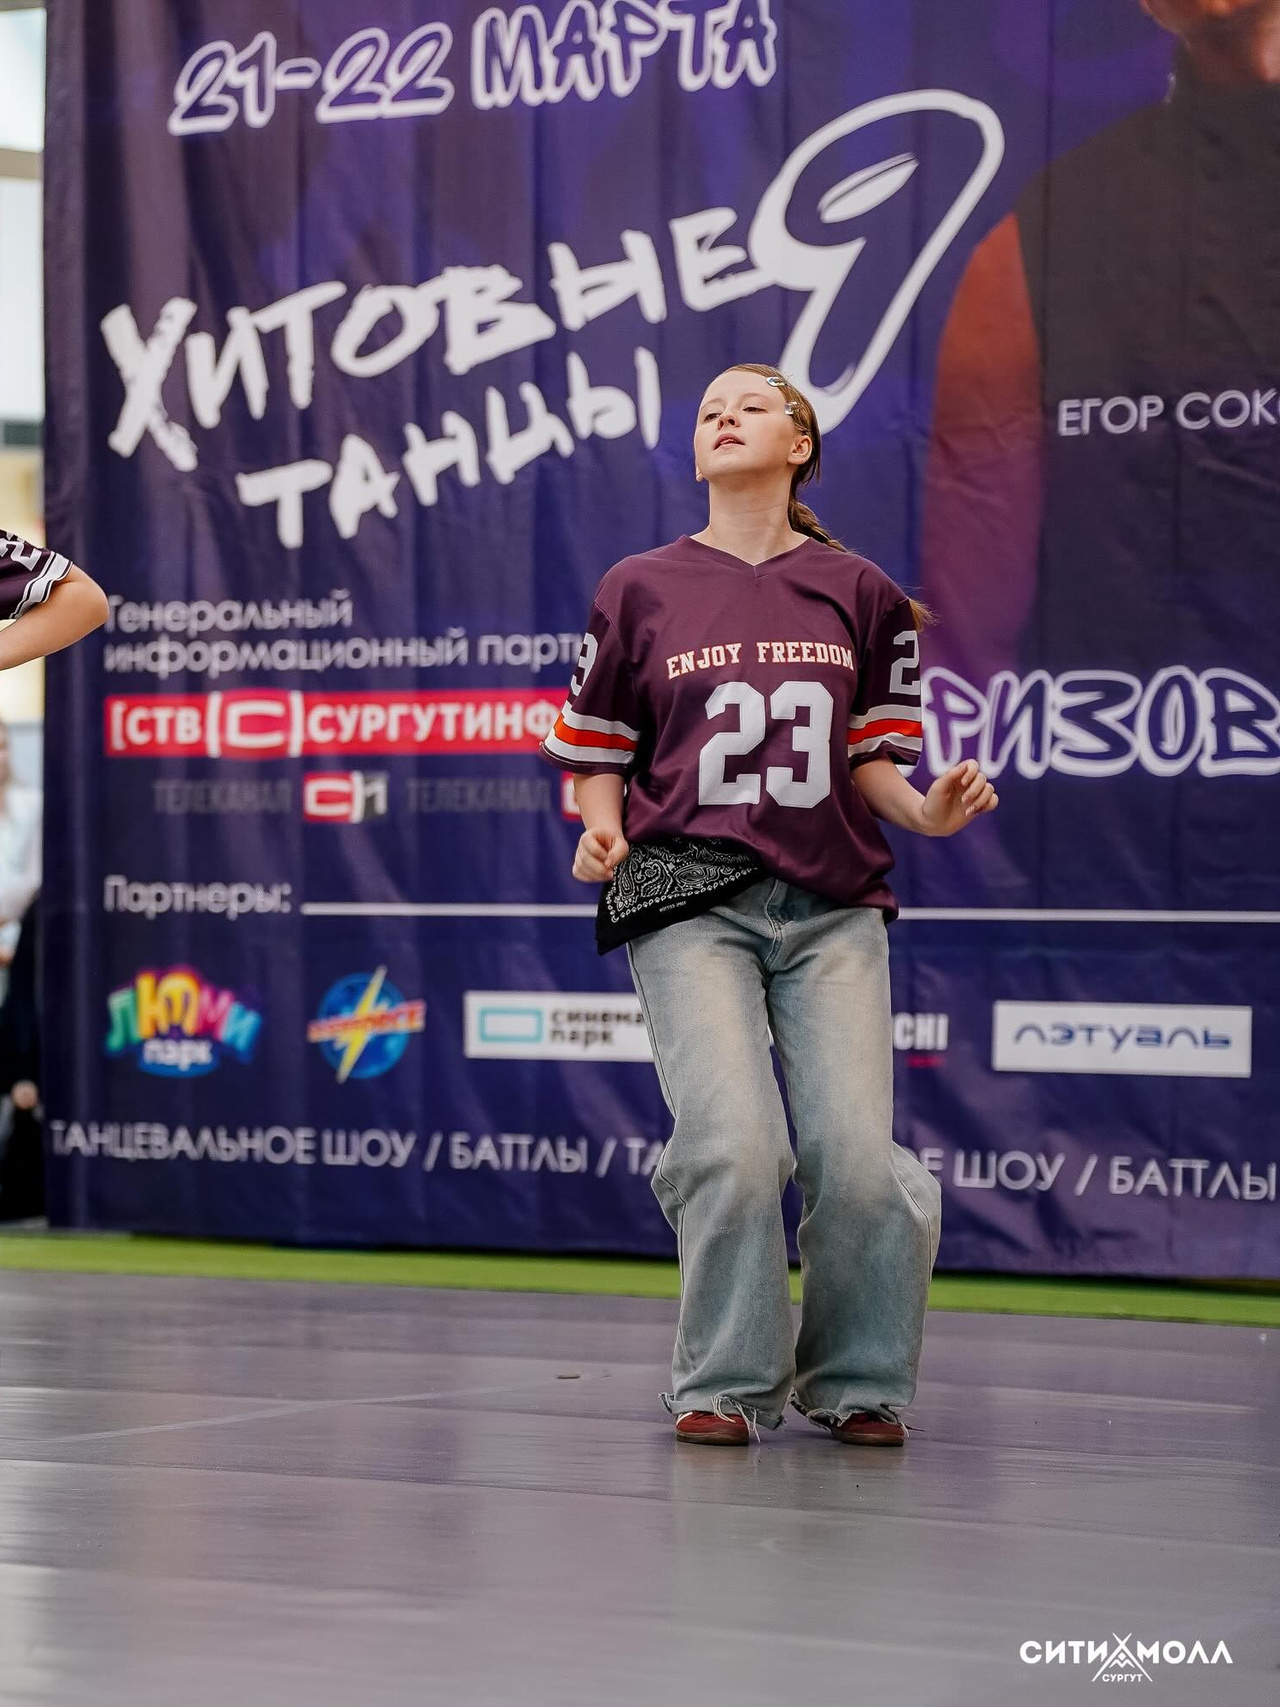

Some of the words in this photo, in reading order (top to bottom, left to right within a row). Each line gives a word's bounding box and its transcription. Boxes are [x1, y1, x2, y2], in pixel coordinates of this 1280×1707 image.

[167, 22, 455, 136] 21-22
[470, 0, 778, 110] МАРТА
[101, 206, 770, 472] ХИТОВЫЕ
[1057, 394, 1164, 436] ЕГОР
[1175, 387, 1280, 431] СОК
[235, 346, 662, 550] ТАНЦЫ
[104, 588, 354, 639] Генеральный
[103, 627, 469, 681] информационный
[668, 643, 742, 680] ENJOY
[756, 641, 855, 671] FREEDOM
[699, 681, 834, 809] 23
[896, 664, 1280, 779] РИЗОВ
[103, 874, 292, 921] Партнеры:
[50, 1119, 317, 1165] ТАНЦЕВАЛЬНОЕ
[323, 1127, 416, 1167] ШОУ
[451, 1132, 589, 1174] БАТТЛЫ
[953, 1149, 1066, 1192] ШОУ
[1108, 1155, 1277, 1202] БАТТЛЫ
